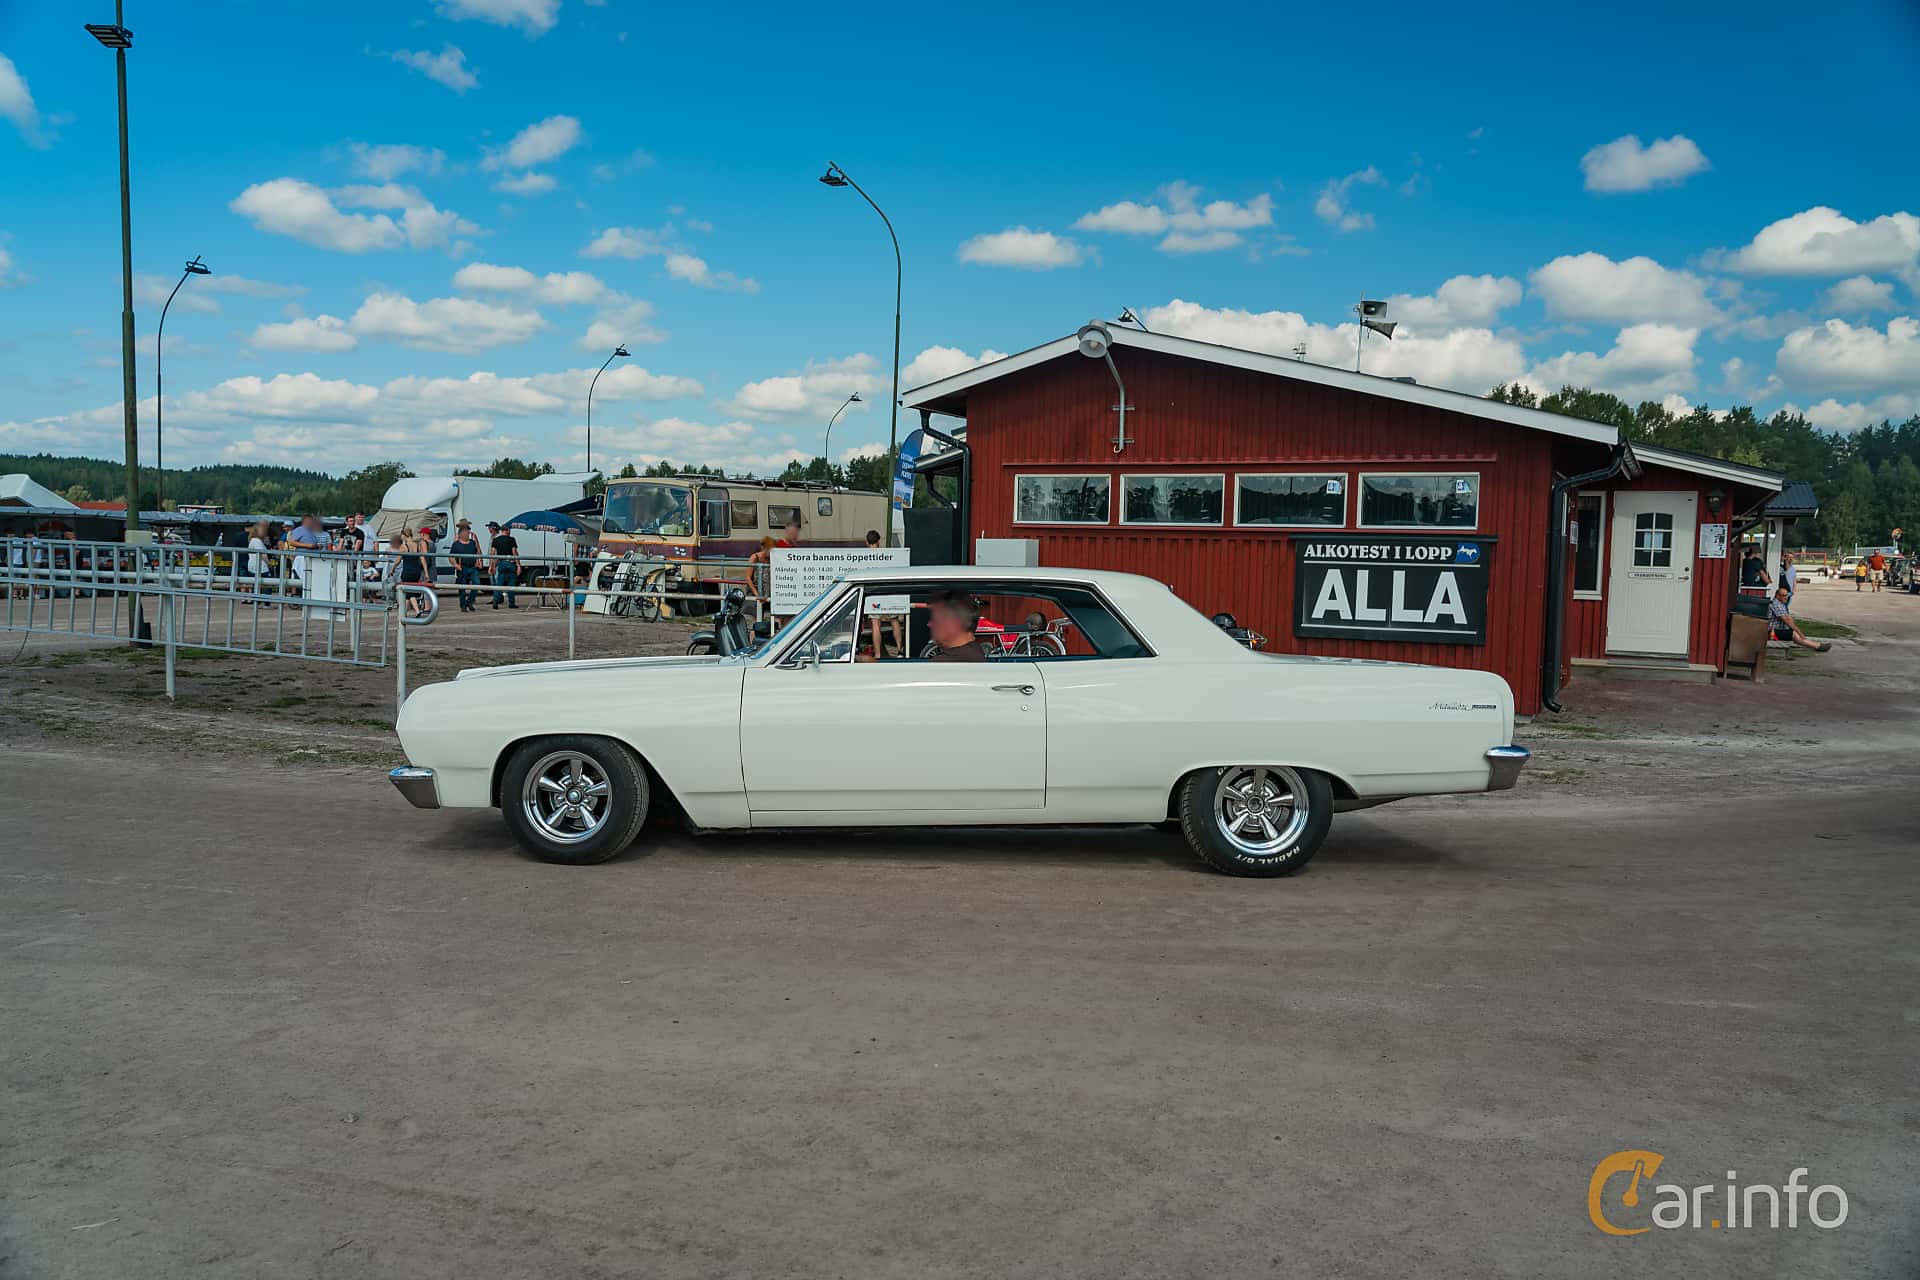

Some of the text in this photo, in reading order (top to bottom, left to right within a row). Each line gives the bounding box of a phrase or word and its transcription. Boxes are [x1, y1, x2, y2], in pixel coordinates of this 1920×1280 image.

[787, 553, 893, 563] Stora banans öppettider
[1304, 544, 1453, 561] ALKOTEST I LOPP
[1311, 568, 1468, 625] ALLA
[1258, 846, 1301, 865] RADIAL
